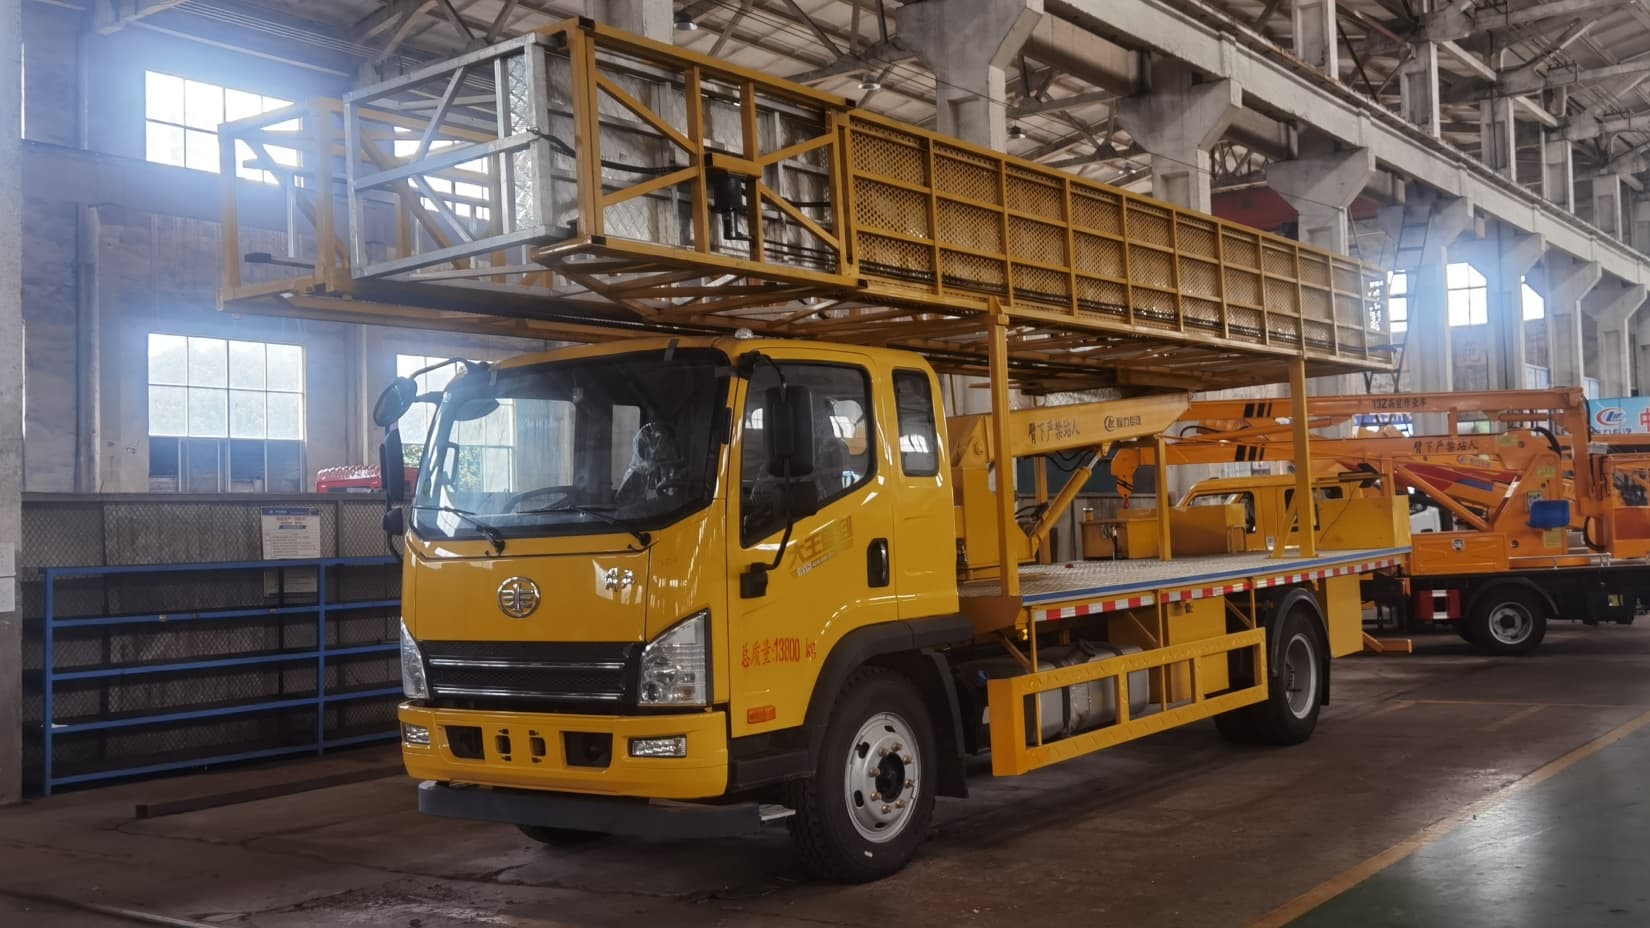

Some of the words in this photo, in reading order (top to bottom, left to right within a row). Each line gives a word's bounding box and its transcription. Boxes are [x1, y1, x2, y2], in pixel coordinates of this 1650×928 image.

[1028, 416, 1080, 445] 臂下严禁站人
